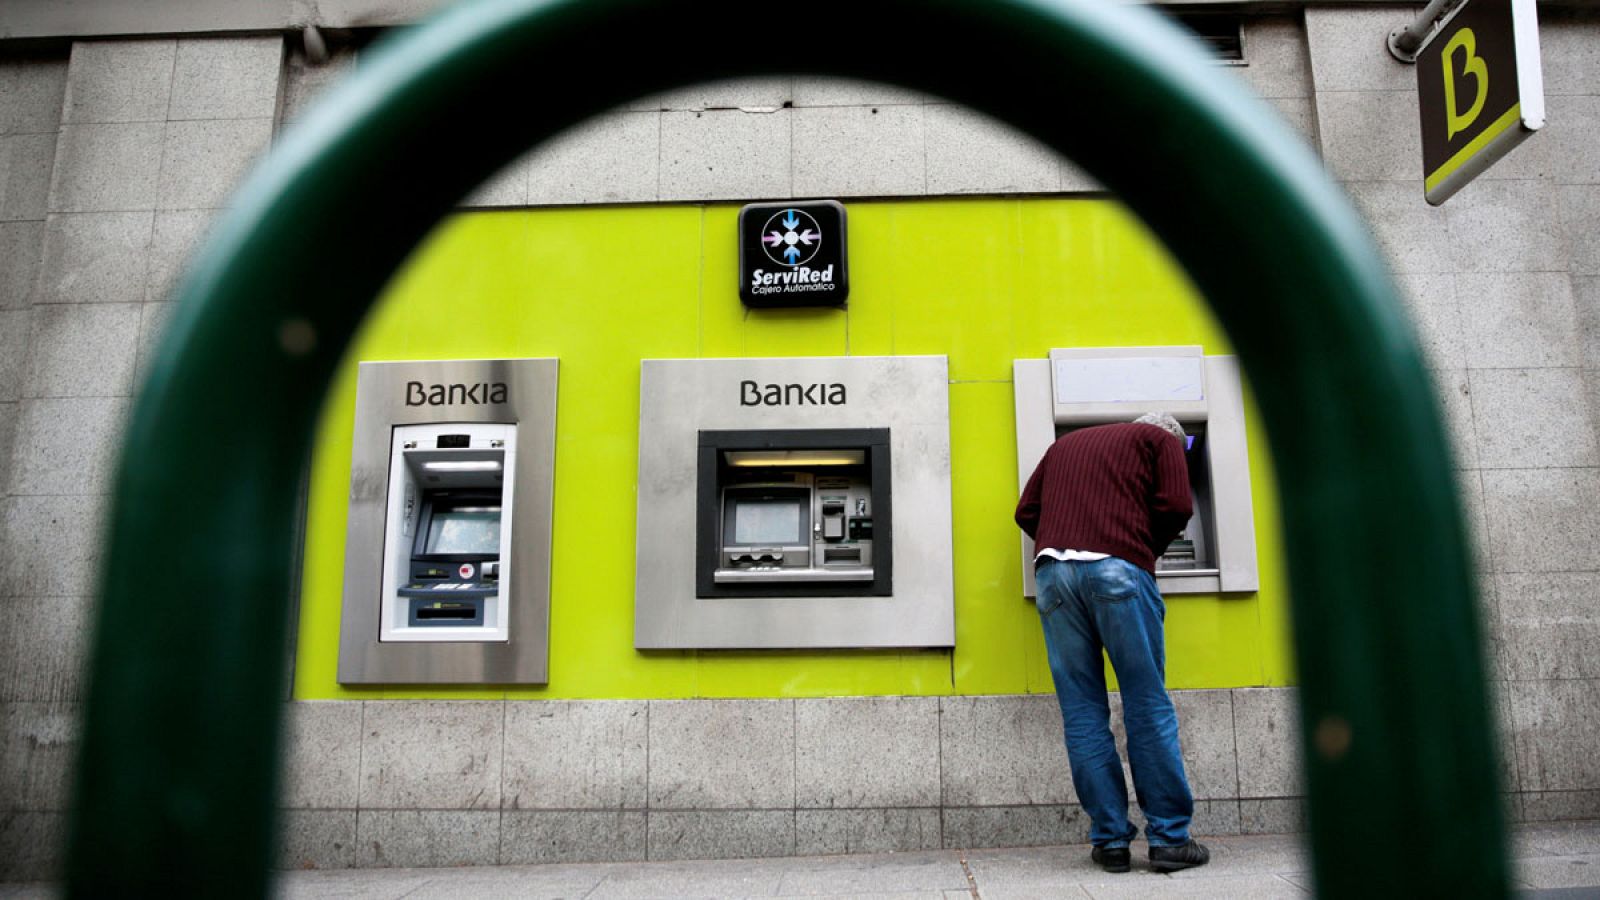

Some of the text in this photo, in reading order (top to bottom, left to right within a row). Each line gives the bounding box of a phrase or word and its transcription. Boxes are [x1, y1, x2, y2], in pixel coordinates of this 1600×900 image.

[1441, 27, 1489, 142] B
[751, 263, 834, 286] ServiRed
[751, 285, 782, 296] Cajero
[405, 380, 508, 407] Bankia
[740, 380, 846, 407] Bankia
